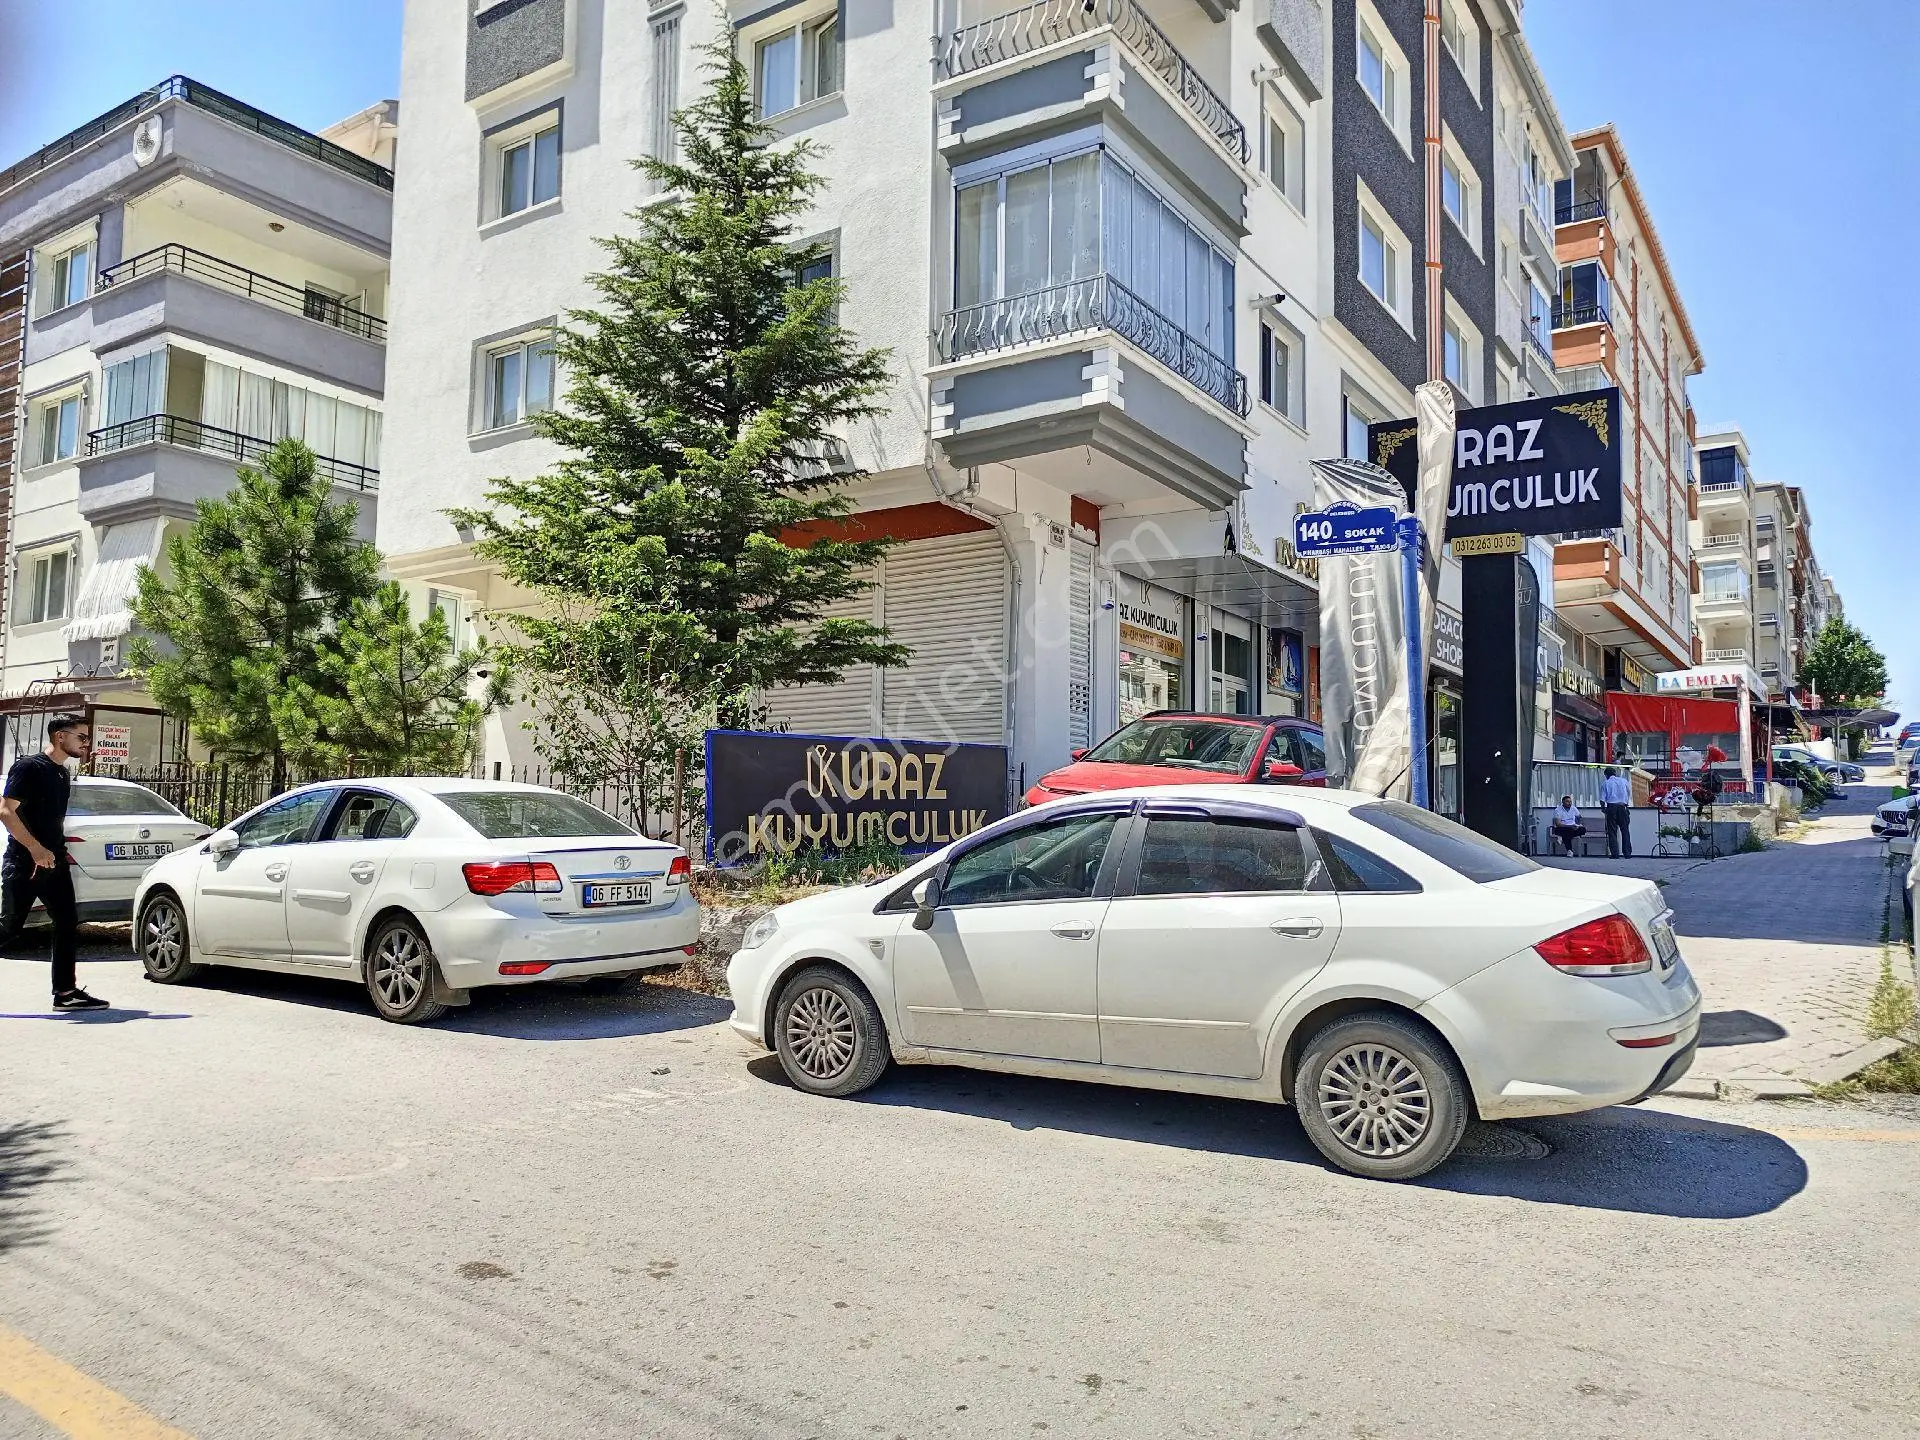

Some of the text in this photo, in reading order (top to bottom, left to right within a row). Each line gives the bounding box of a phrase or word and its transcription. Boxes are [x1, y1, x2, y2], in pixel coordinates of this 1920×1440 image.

[1457, 418, 1544, 469] RAZ
[1447, 467, 1601, 517] UMCULUK
[1344, 526, 1385, 539] SOKAK
[1455, 535, 1516, 552] 0312 263 03 05
[1130, 606, 1178, 637] KUYUMCULUK
[1436, 638, 1463, 666] SHOP
[1685, 673, 1742, 687] EMLAK
[97, 740, 128, 749] KİRALIK
[748, 809, 987, 854] KUYUMCULUK
[113, 844, 173, 857] 06 ABG 864
[592, 887, 604, 901] 06
[610, 886, 622, 900] FF
[626, 885, 649, 899] 5144
